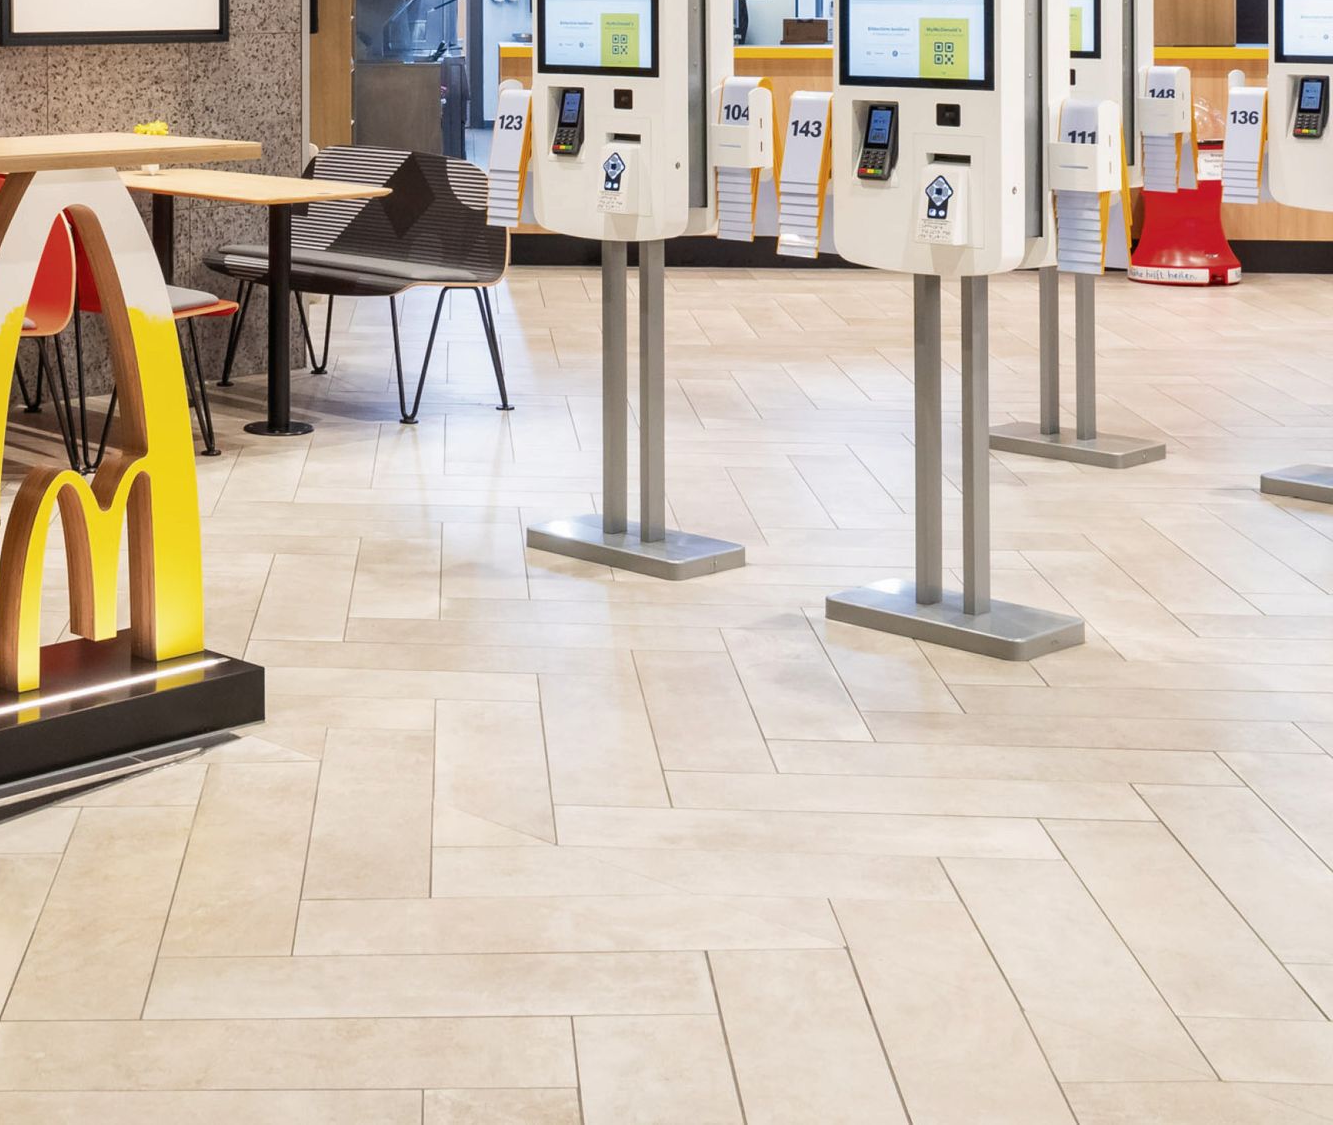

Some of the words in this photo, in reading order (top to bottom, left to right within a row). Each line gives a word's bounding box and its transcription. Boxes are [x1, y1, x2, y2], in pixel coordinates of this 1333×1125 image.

[499, 114, 523, 130] 123
[1230, 110, 1259, 125] 136
[791, 119, 822, 137] 143
